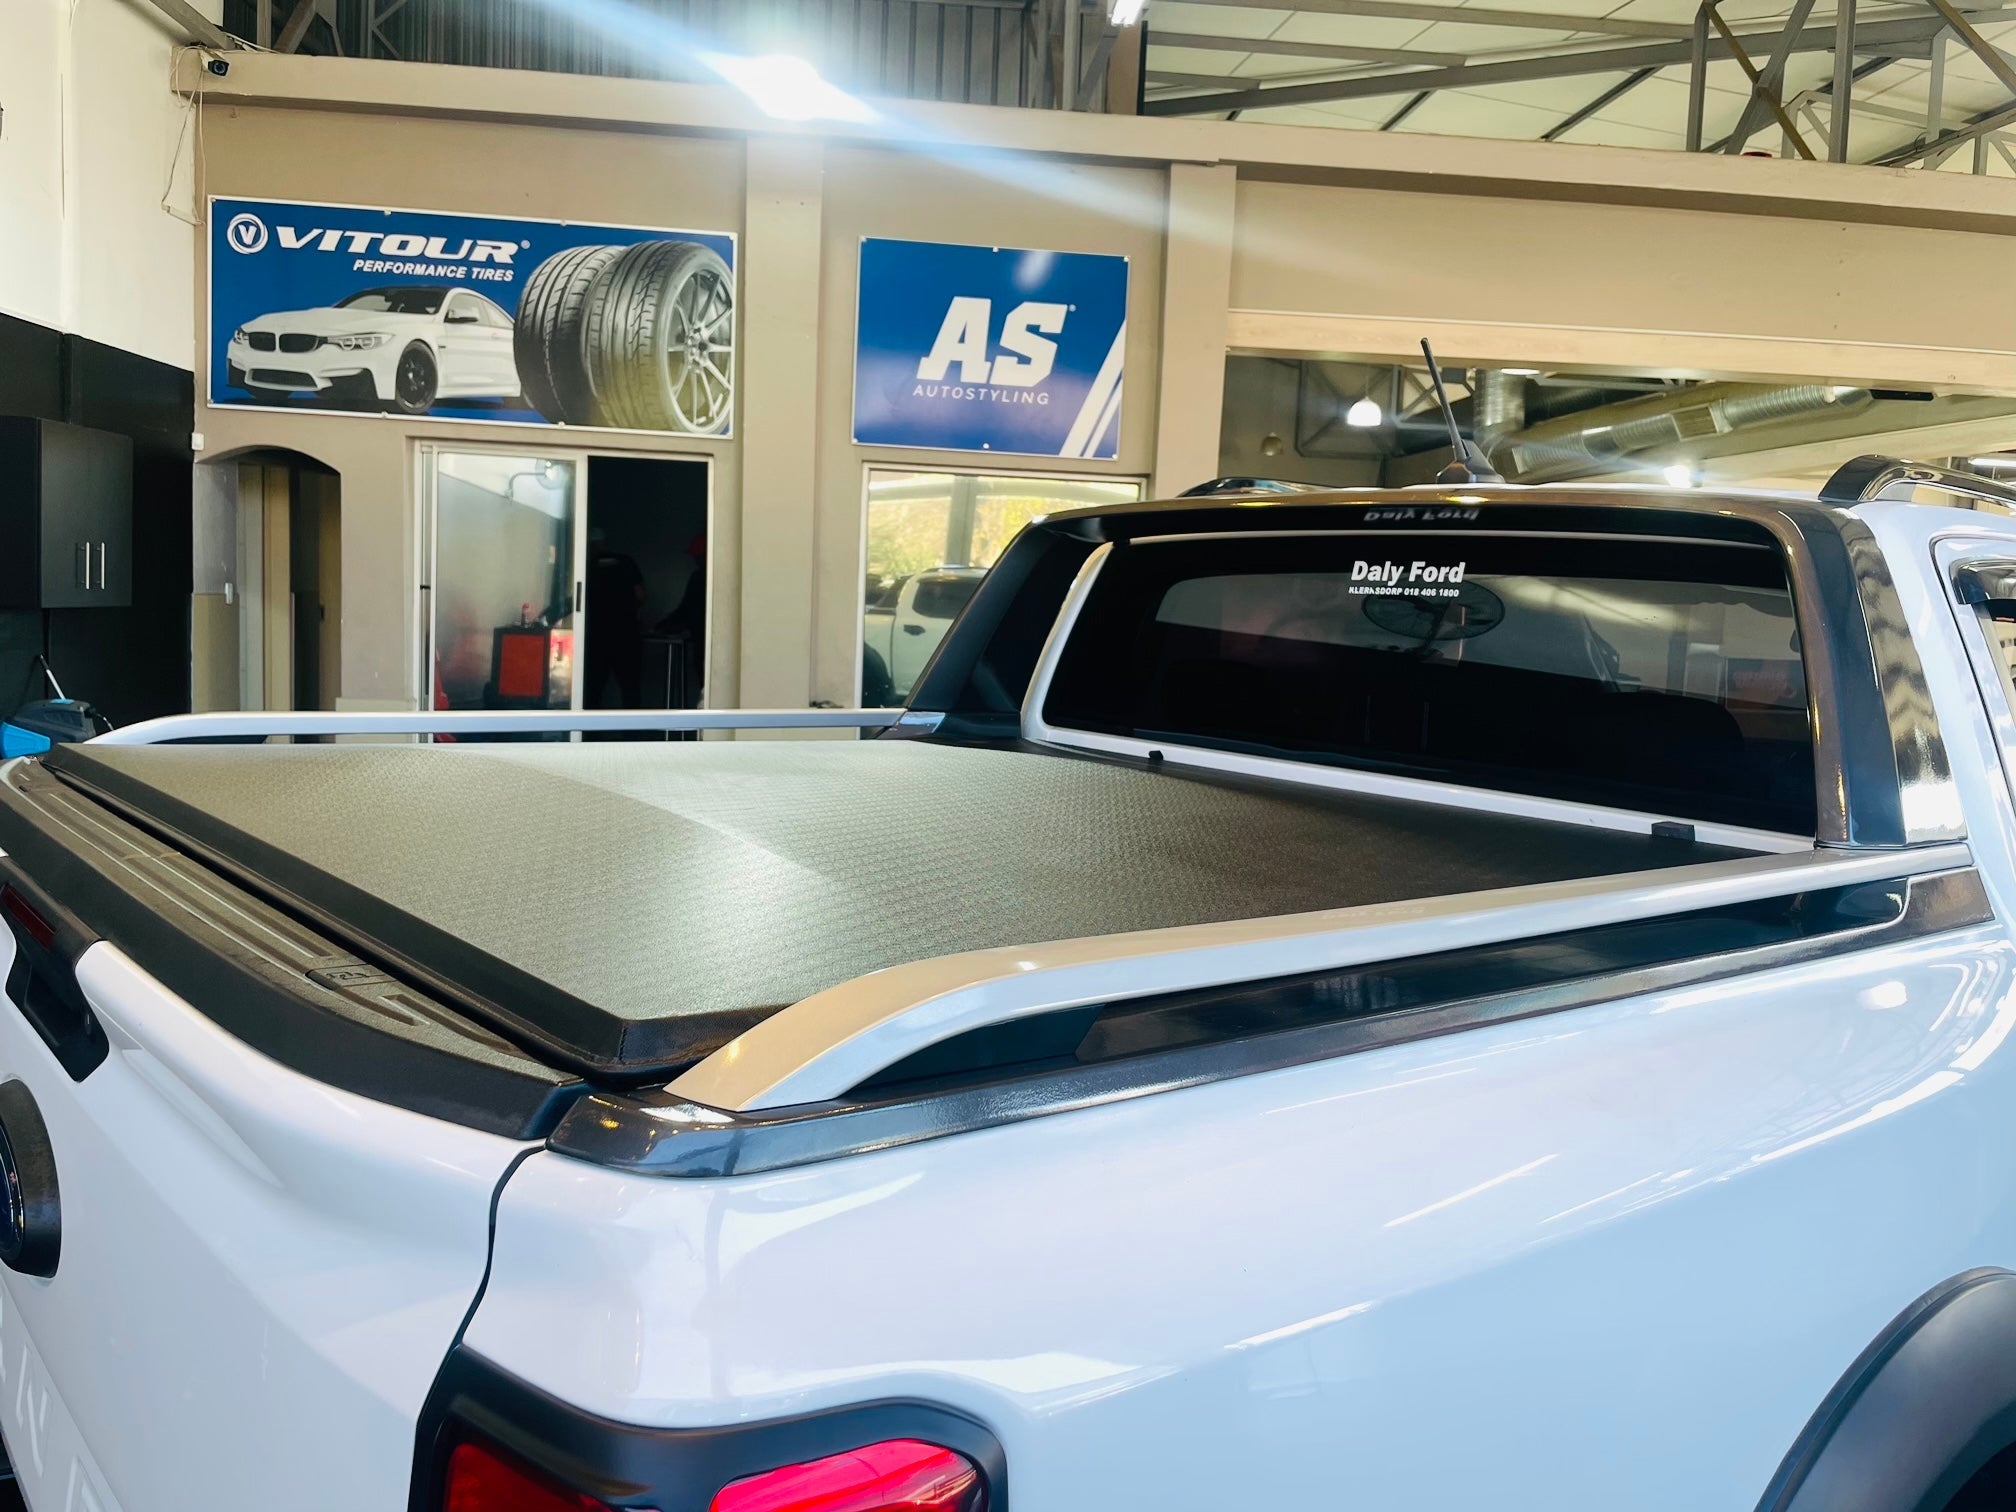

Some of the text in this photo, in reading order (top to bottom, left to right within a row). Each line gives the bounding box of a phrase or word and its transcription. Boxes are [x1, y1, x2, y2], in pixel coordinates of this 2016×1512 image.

[276, 226, 518, 264] VITOUR
[353, 259, 514, 282] PERFORMANCE TIRES
[916, 296, 1068, 387] AS
[912, 384, 1049, 405] AUTOSTYLING
[1351, 560, 1466, 586] Daly Ford
[1403, 587, 1420, 597] 018
[1420, 588, 1437, 597] 406
[1438, 588, 1460, 598] 1800
